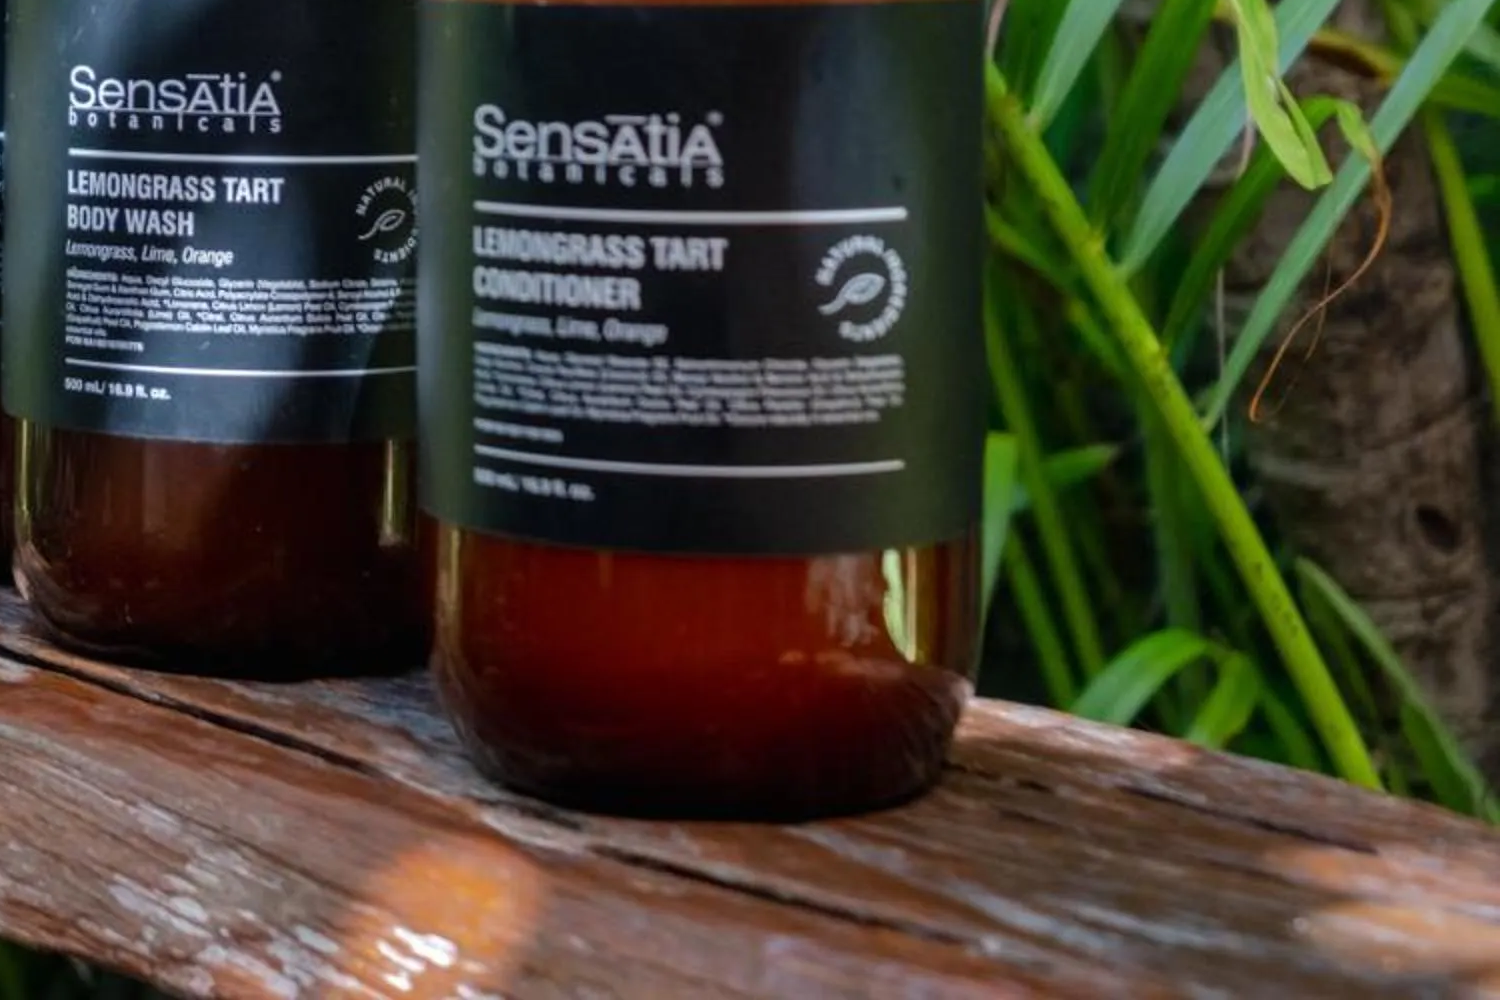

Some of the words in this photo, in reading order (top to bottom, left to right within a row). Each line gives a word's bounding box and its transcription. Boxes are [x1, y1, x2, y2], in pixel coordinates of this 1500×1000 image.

[69, 106, 281, 133] botanicals
[67, 169, 216, 203] LEMONGRASS
[221, 177, 285, 204] TART
[355, 176, 405, 216] NATURAL
[67, 204, 118, 233] BODY
[124, 207, 195, 237] WASH
[65, 239, 138, 263] Lemongrass,
[141, 244, 179, 265] Lime,
[182, 246, 234, 268] Orange
[473, 225, 646, 270] LEMONGRASS
[649, 236, 729, 271] TART
[473, 266, 642, 311] CONDITIONER
